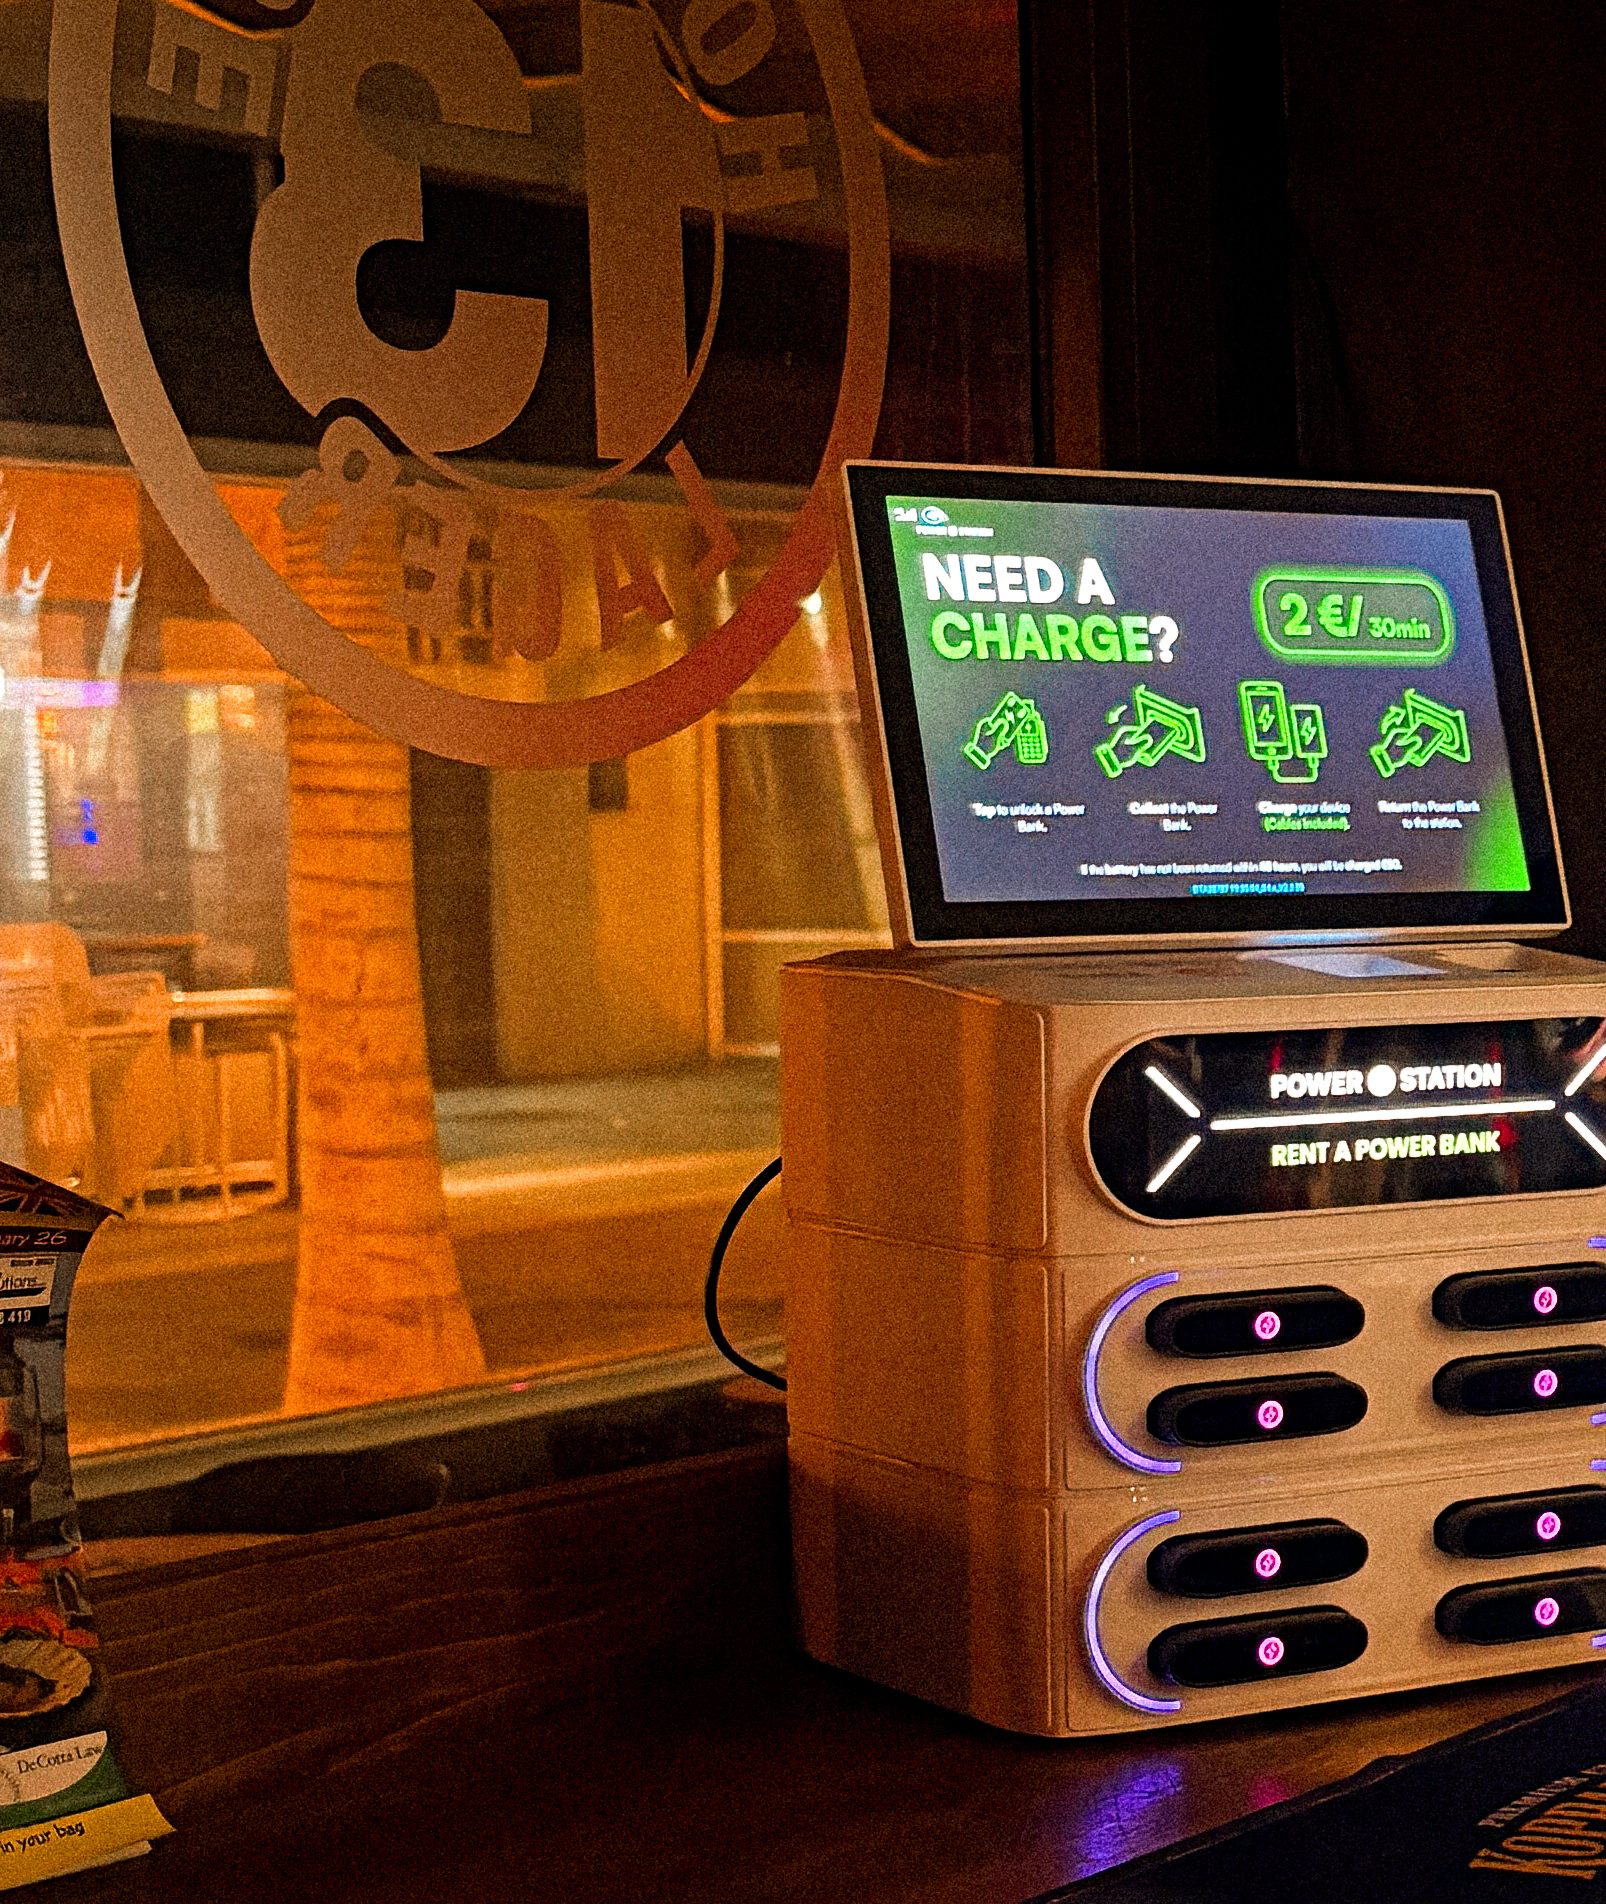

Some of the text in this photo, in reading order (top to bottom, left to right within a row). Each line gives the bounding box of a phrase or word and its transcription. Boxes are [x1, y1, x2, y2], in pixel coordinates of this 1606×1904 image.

[922, 552, 1116, 605] NEED A
[1279, 592, 1312, 636] 2
[1368, 616, 1432, 639] 30min
[931, 610, 1179, 663] CHARGE?
[1052, 802, 1085, 816] Power
[1270, 1063, 1502, 1100] POWER STATION
[1271, 1129, 1502, 1168] RENT A POWER BANK
[0, 1230, 67, 1247] ary 26
[17, 1746, 102, 1774] DeCotta Law
[17, 1831, 52, 1852] your
[52, 1822, 86, 1839] bag
